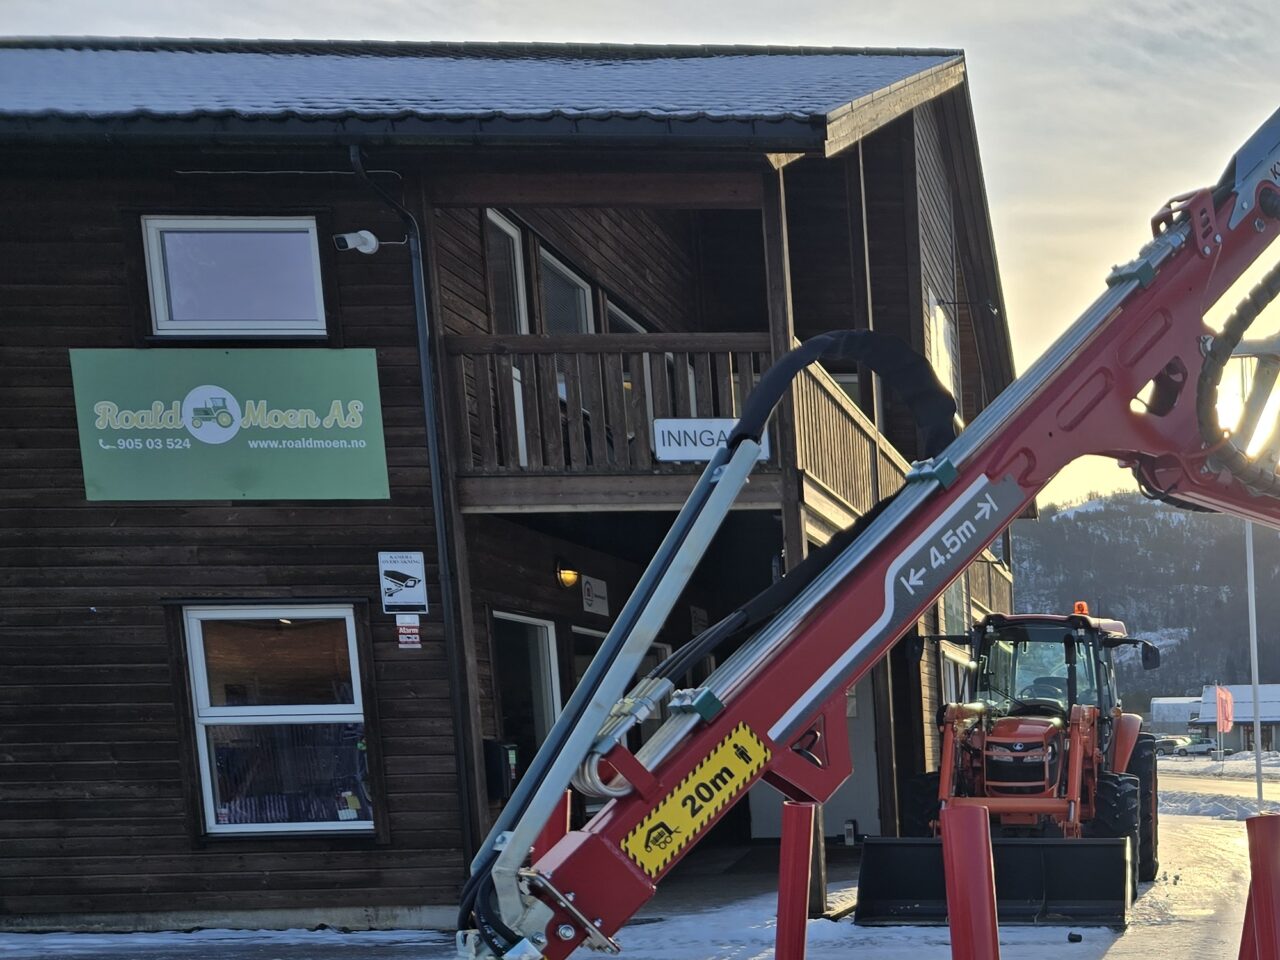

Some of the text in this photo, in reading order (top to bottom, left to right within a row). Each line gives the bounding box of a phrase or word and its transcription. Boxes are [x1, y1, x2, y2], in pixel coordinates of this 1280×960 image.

[94, 400, 364, 430] Roald Moen AS
[117, 438, 191, 449] 905 03 524
[248, 437, 367, 449] www.roaldmoen.no
[661, 430, 729, 447] INNGA
[929, 520, 977, 569] 4.5m
[399, 626, 419, 634] Alarm
[681, 766, 735, 818] 20m
